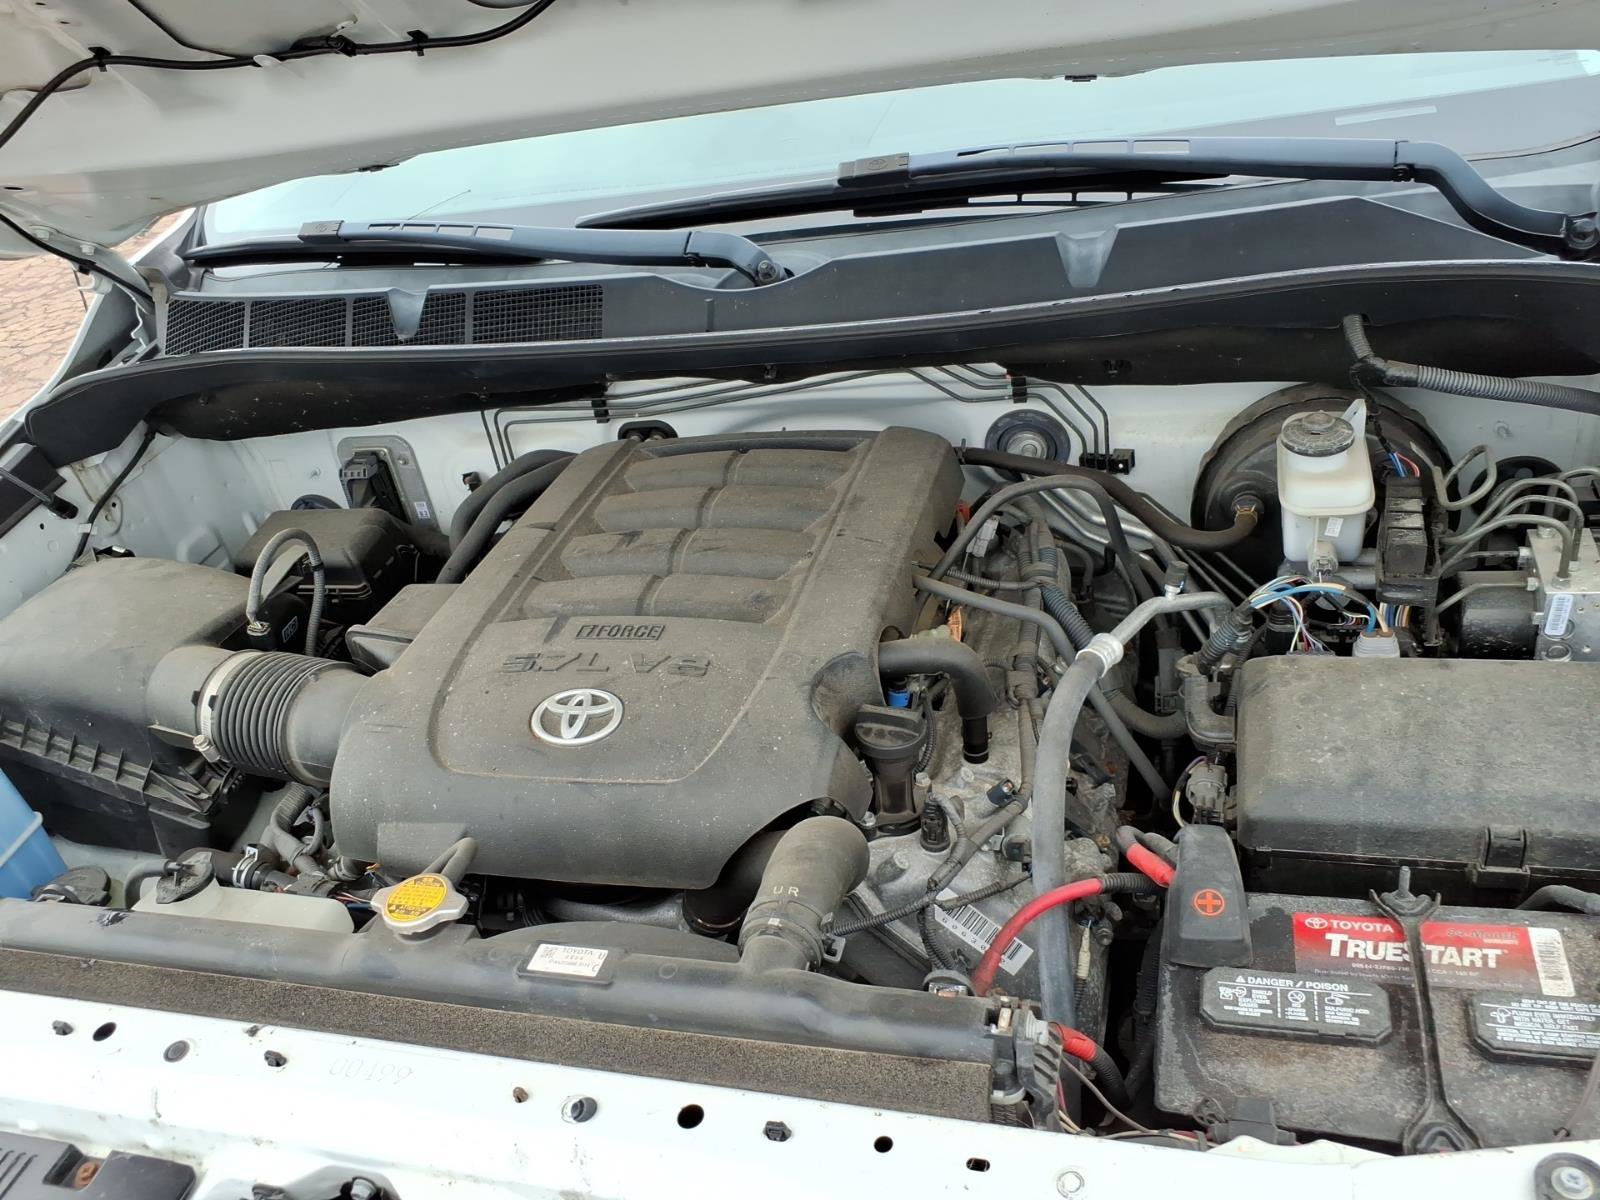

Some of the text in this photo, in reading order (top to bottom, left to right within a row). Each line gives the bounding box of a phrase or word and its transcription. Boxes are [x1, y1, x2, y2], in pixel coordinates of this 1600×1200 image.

[1330, 919, 1395, 934] TOYOTA
[1247, 976, 1294, 987] DANGER
[1305, 981, 1349, 992] POISON
